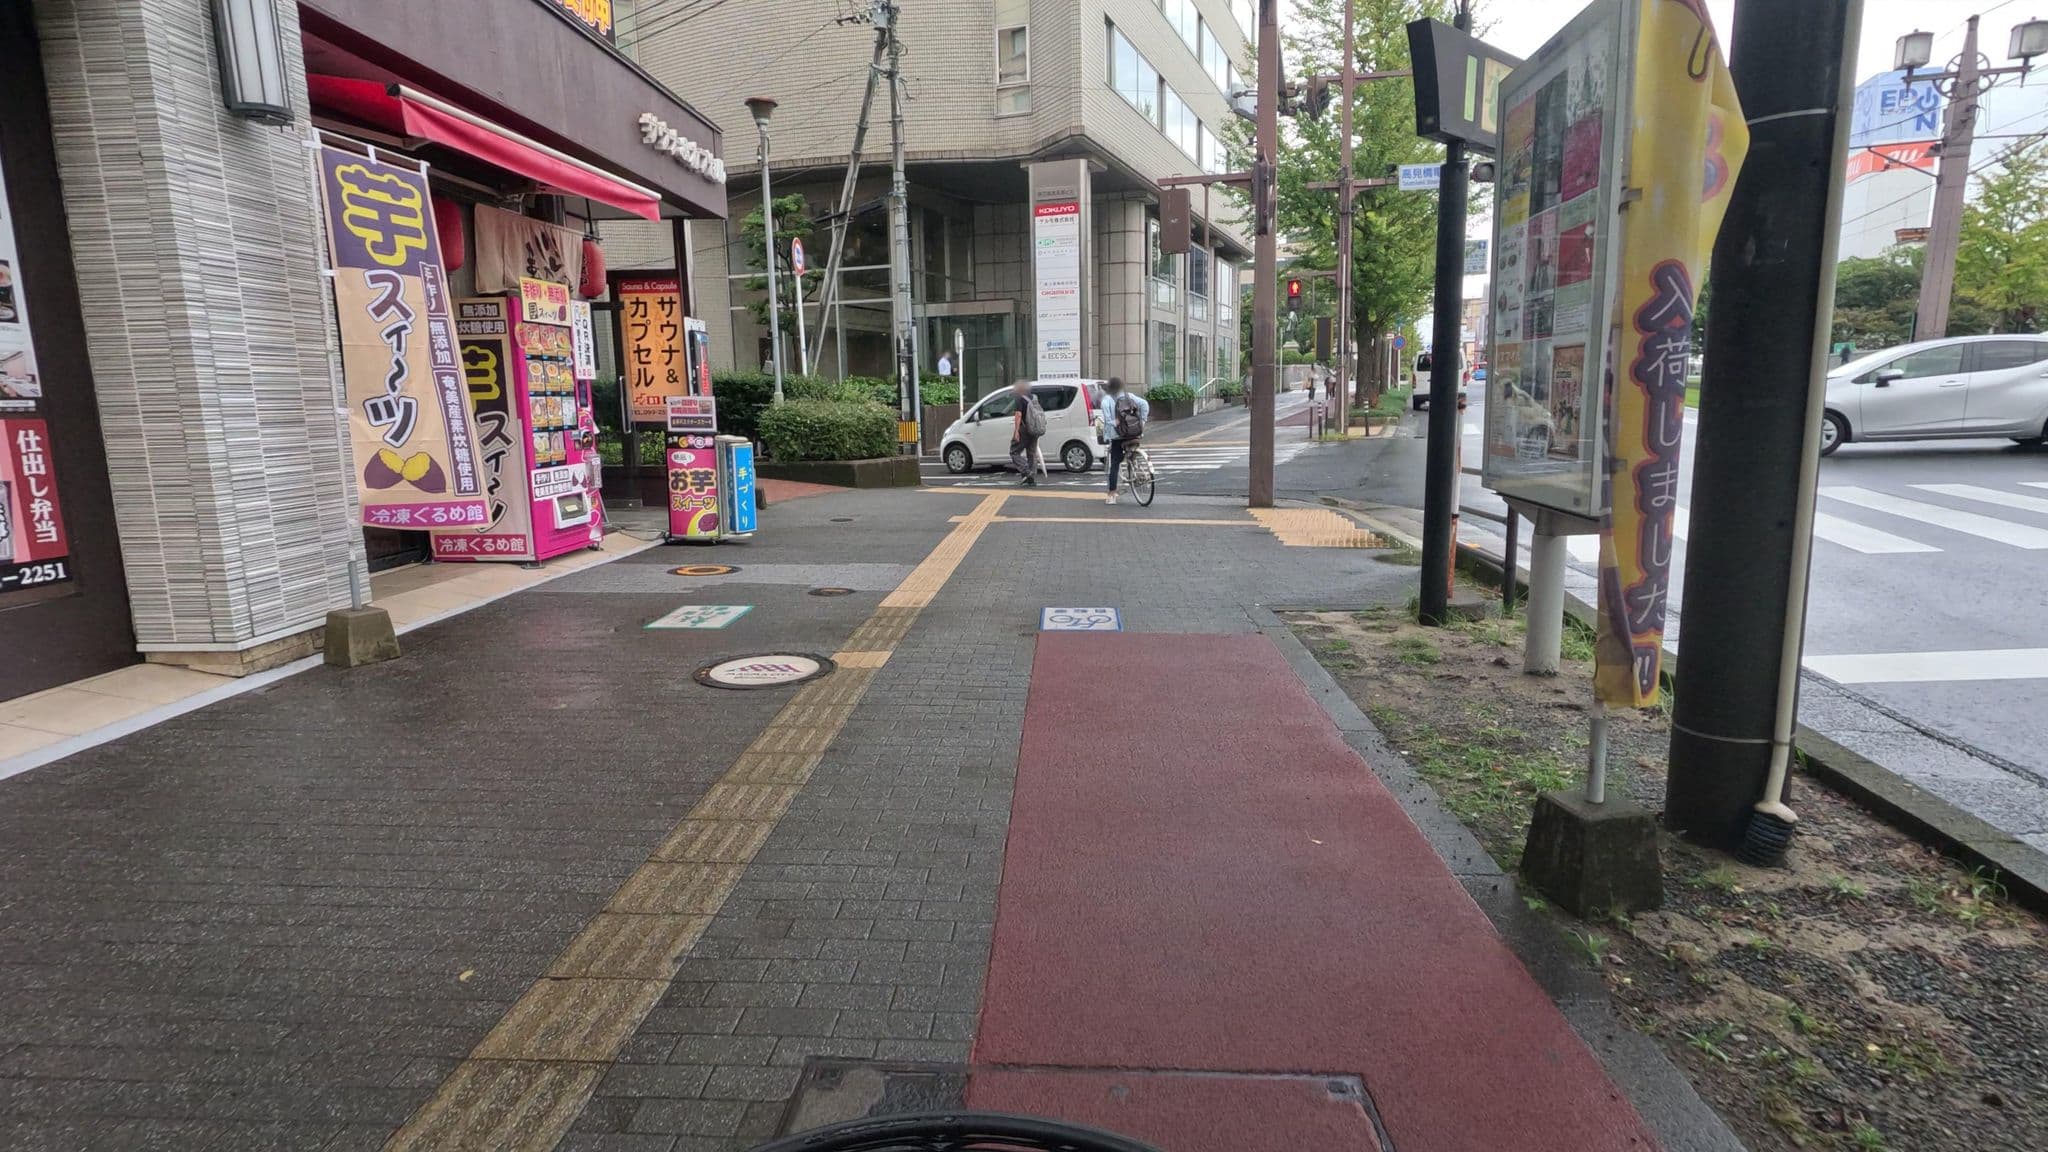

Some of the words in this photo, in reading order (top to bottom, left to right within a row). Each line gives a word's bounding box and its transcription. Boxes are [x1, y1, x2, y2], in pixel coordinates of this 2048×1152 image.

[1038, 206, 1075, 214] KOKUYO
[622, 282, 643, 290] Sauna
[644, 282, 650, 290] &
[651, 281, 677, 292] Capsule
[429, 321, 452, 365] 無添加
[629, 296, 655, 388] カプセル
[16, 429, 58, 544] 仕出し弁当
[670, 466, 717, 494] お芋
[672, 495, 716, 511] スイーツ
[738, 466, 749, 528] 手づくり
[370, 503, 484, 524] 冷凍ぐるめ館
[439, 536, 525, 553] 冷凍ぐるめ館
[0, 562, 67, 586] -2251
